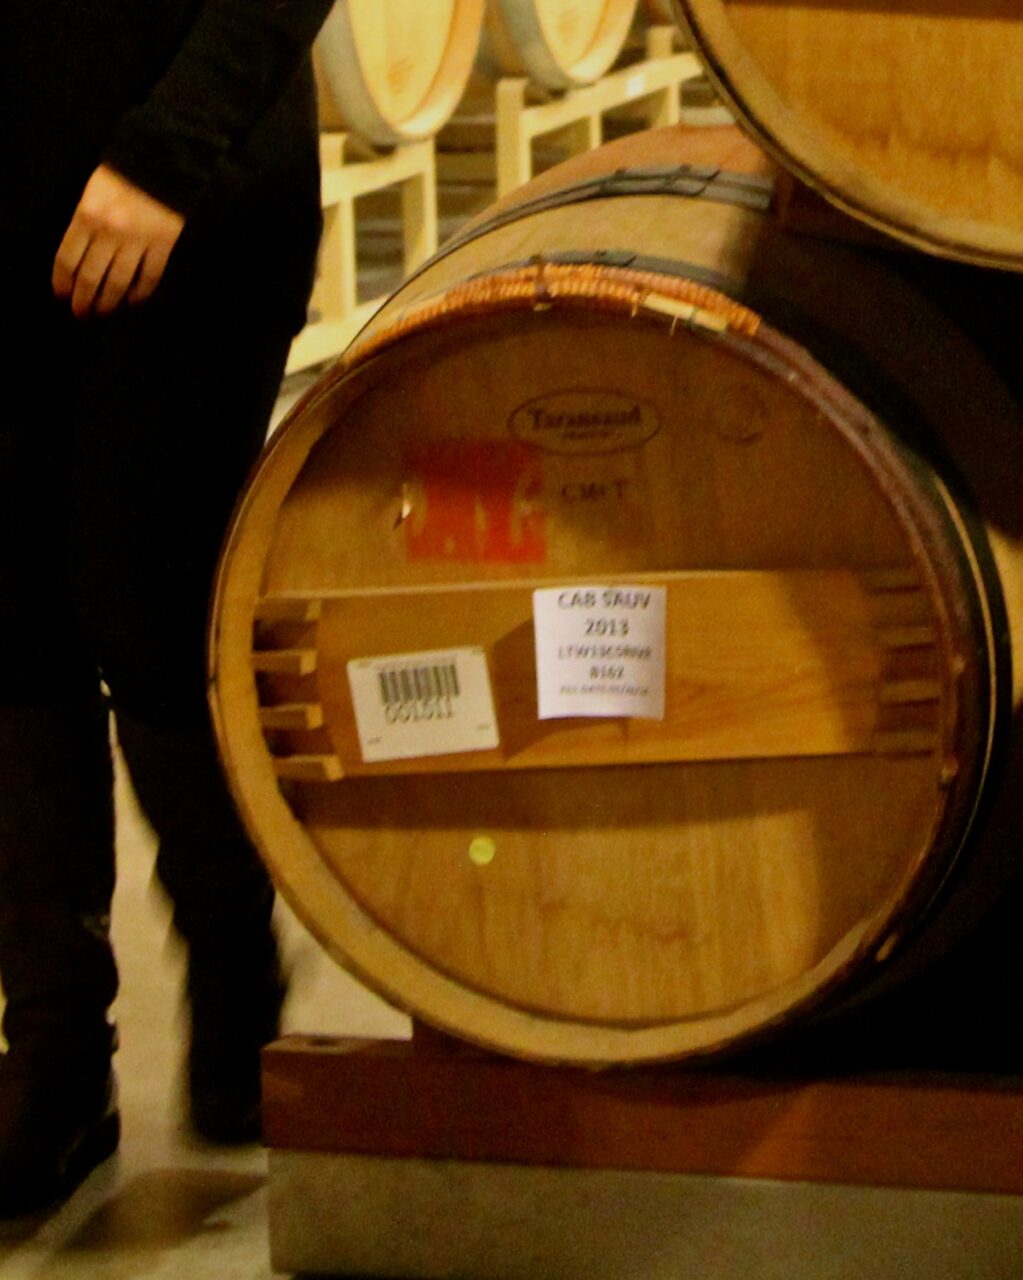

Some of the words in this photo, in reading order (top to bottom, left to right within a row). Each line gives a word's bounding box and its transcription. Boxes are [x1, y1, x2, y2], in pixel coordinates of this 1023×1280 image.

[558, 590, 596, 609] CAB
[602, 590, 651, 609] SAUV
[584, 618, 629, 637] 2013
